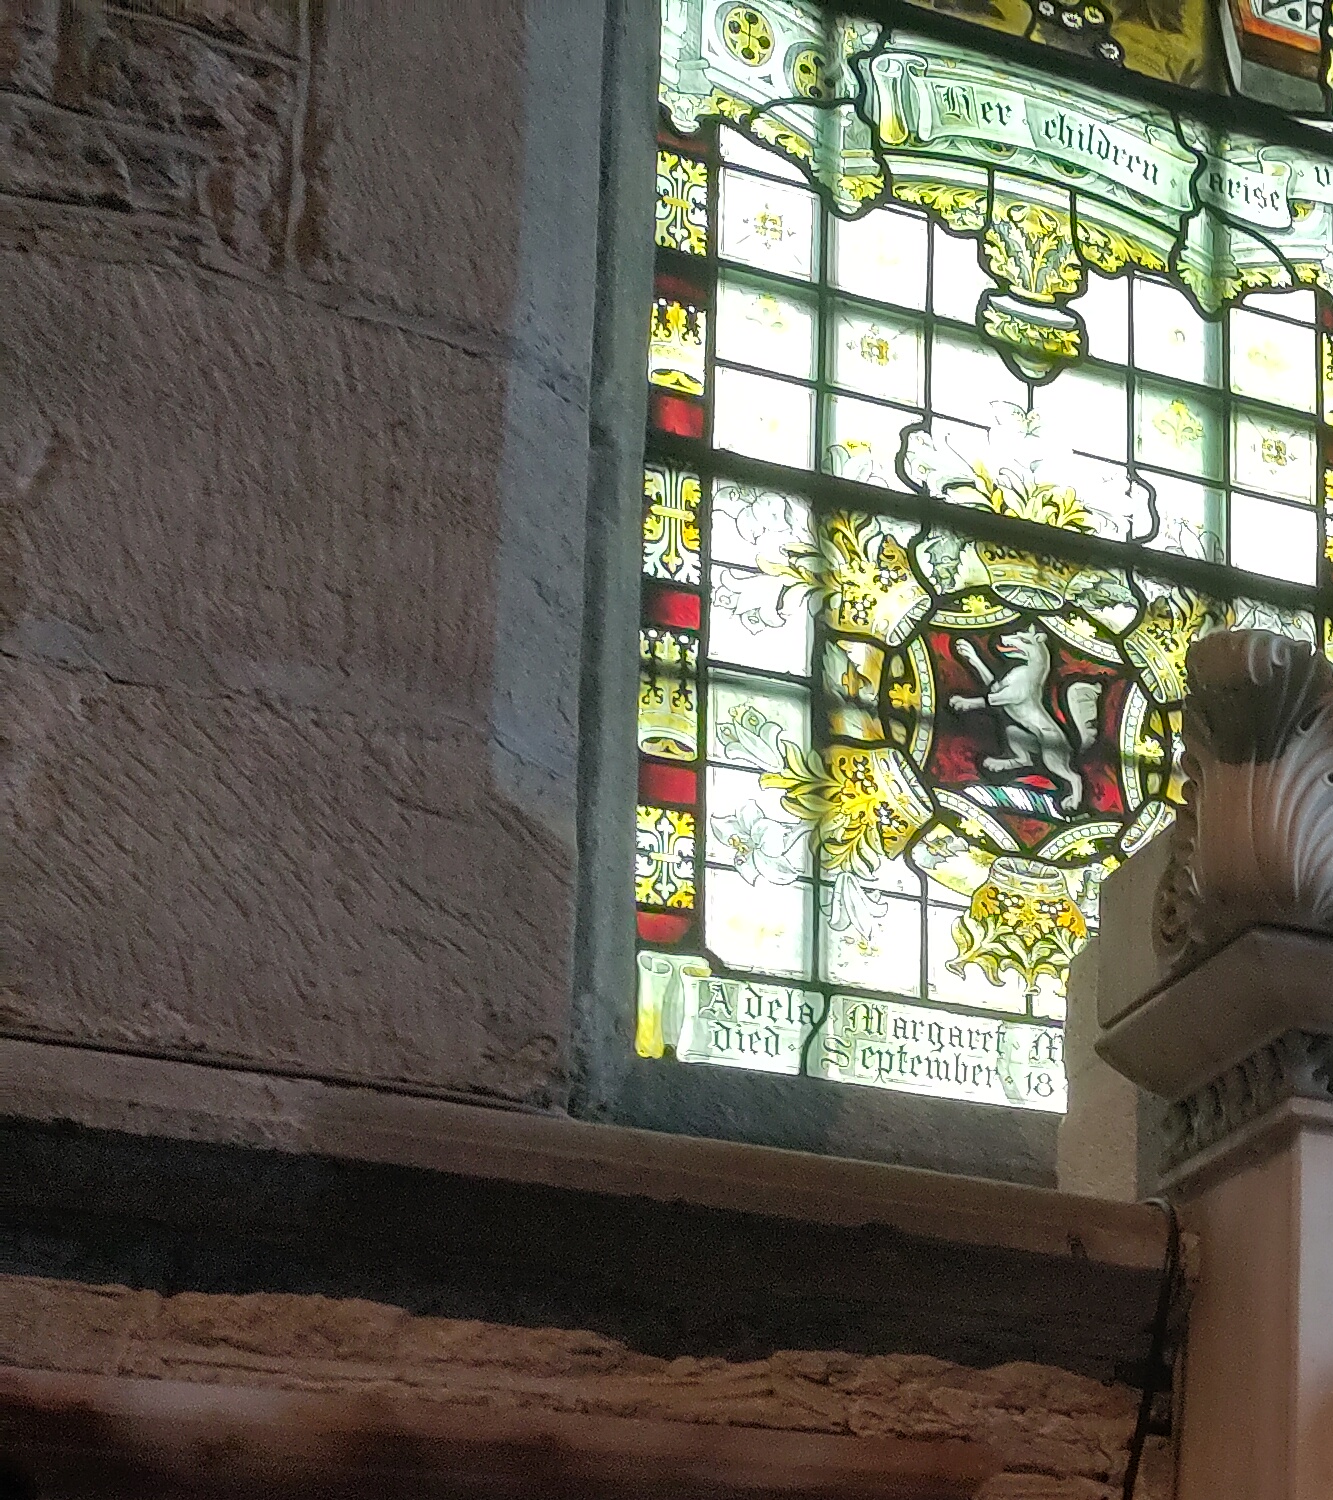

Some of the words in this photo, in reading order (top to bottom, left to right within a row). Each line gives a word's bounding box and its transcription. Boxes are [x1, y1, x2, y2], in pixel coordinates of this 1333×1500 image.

[1044, 111, 1161, 187] children
[1207, 165, 1282, 213] arise
[710, 1021, 782, 1058] died
[820, 1035, 1001, 1089] September
